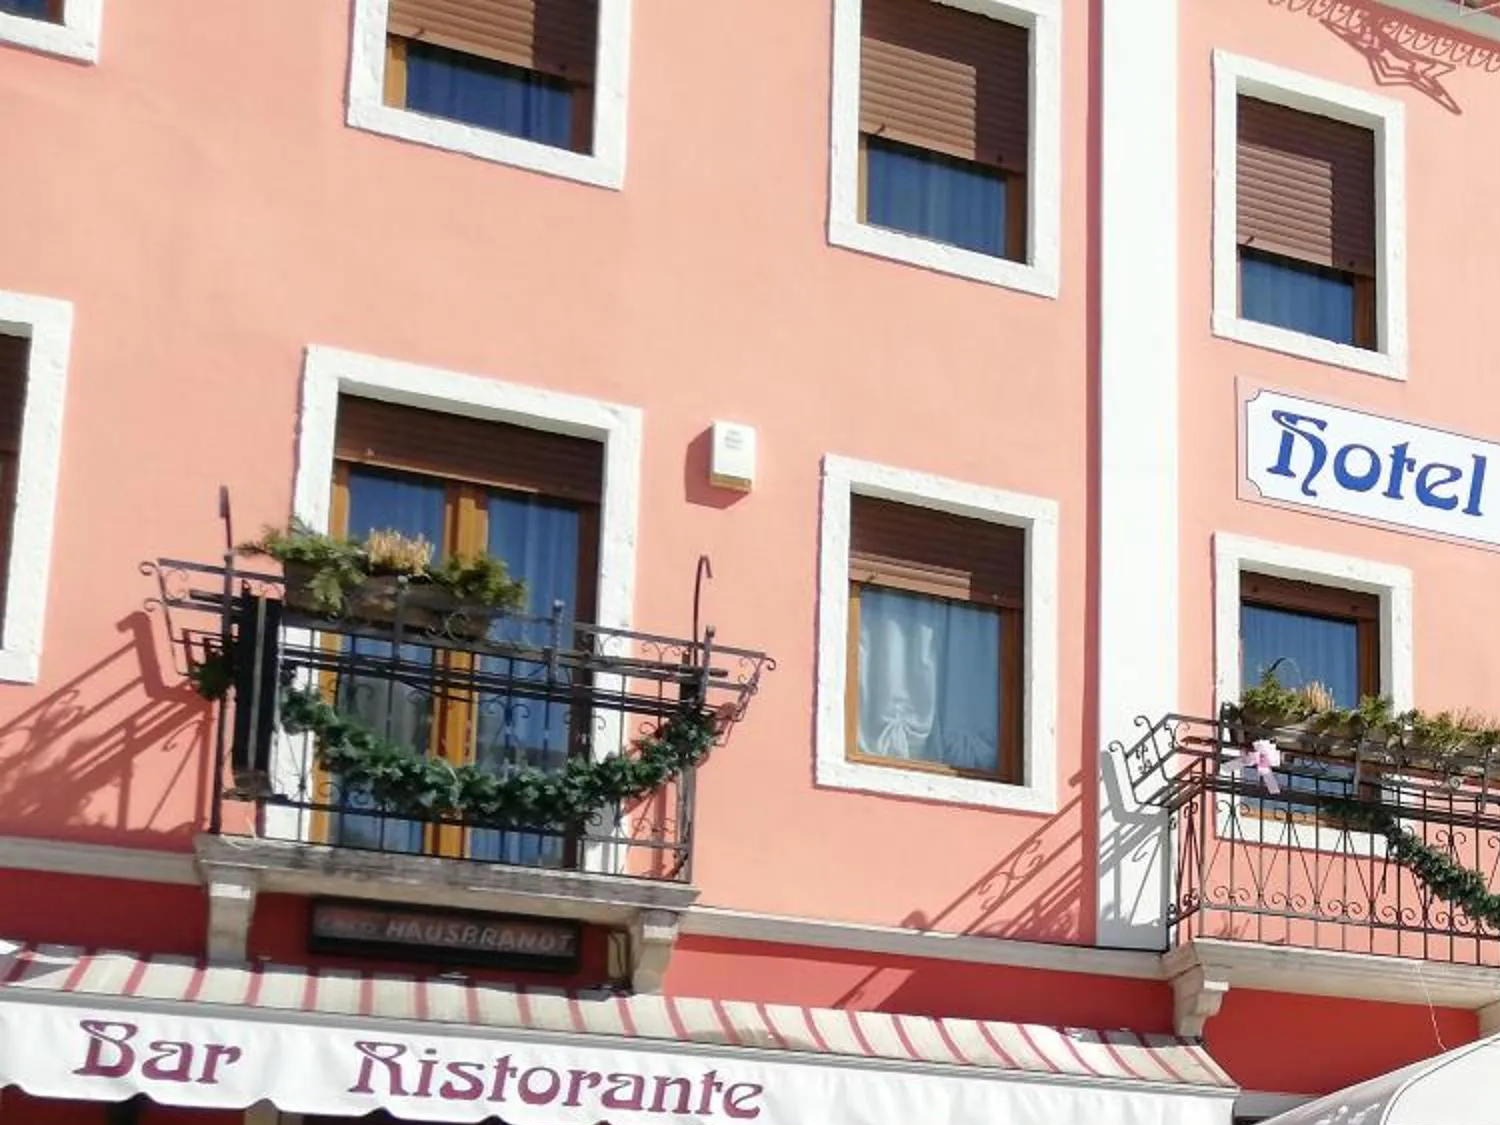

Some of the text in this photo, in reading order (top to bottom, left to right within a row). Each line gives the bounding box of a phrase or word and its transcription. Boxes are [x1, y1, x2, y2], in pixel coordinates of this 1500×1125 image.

[1266, 408, 1487, 517] Hotel
[386, 919, 576, 951] HAUSBRANDT
[72, 1019, 765, 1119] Bar Ristorante
